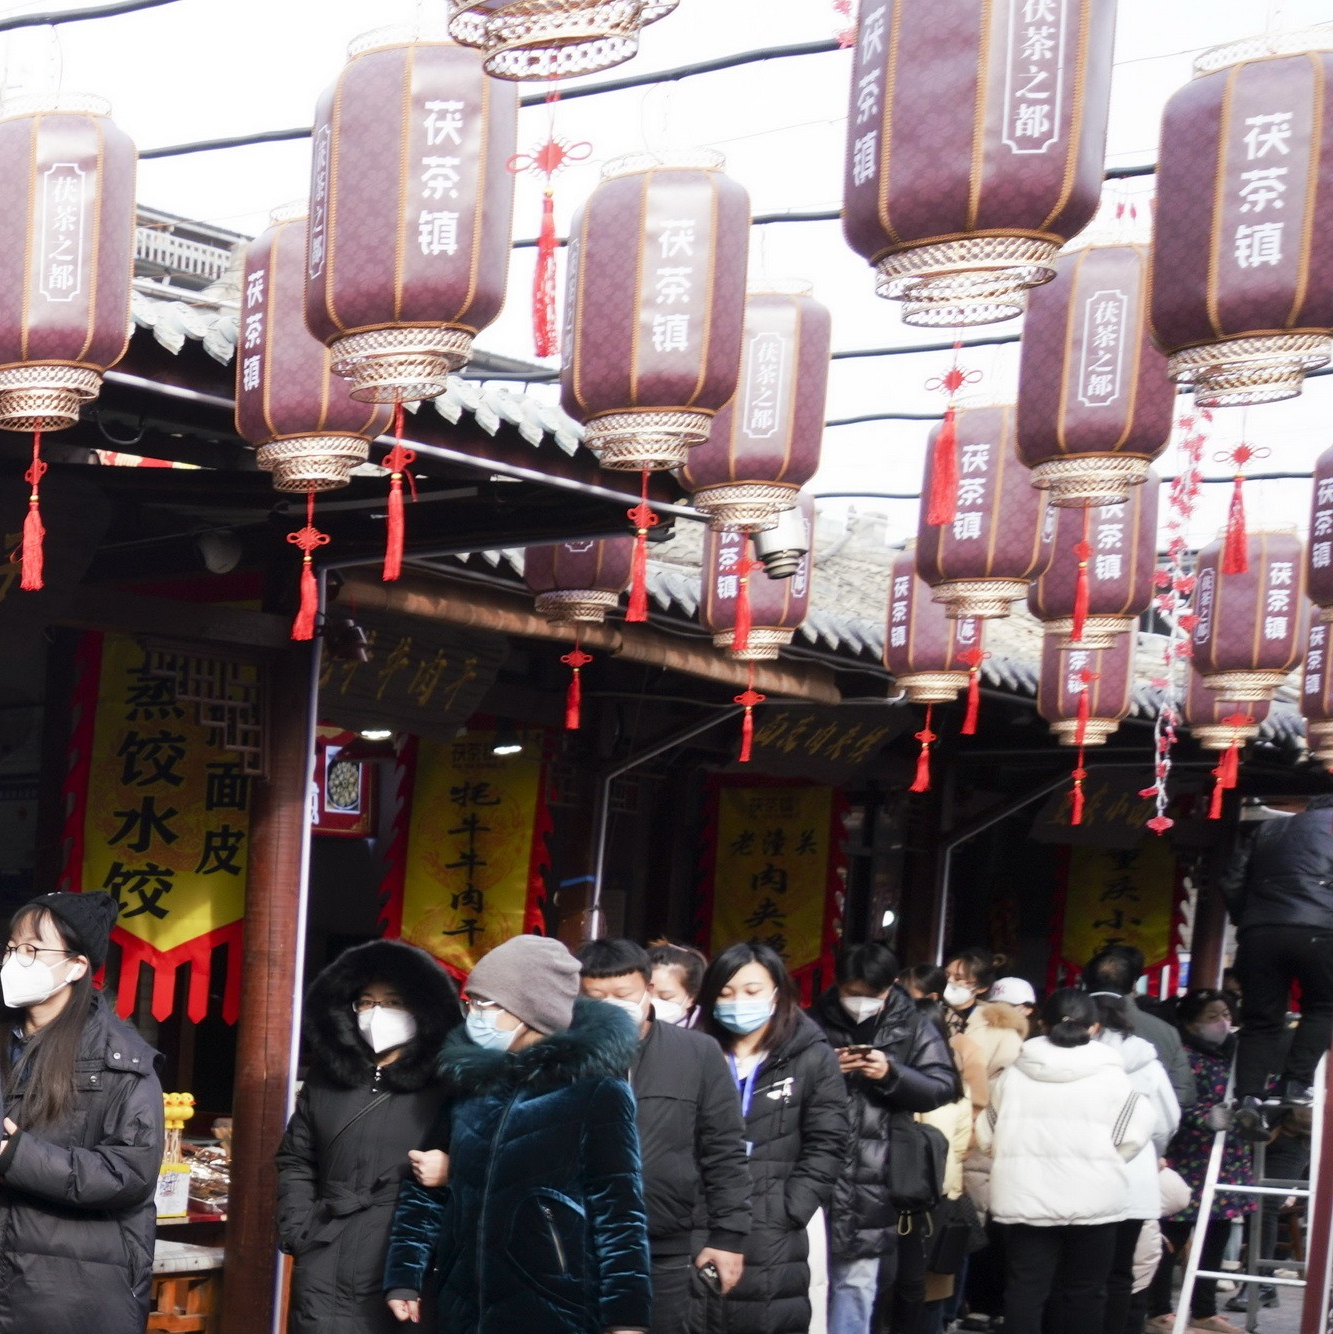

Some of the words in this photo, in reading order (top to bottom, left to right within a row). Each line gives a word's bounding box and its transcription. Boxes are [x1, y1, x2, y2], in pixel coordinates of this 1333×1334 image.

[852, 5, 884, 187] 茯茶镇
[418, 99, 465, 256] 茯茶镇
[1233, 111, 1294, 268] 茯茶镇
[48, 176, 78, 290] 茯茶之都
[651, 219, 696, 352] 茯茶镇
[243, 269, 265, 392] 茯茶镇
[1085, 300, 1120, 396] 茯茶之都
[750, 341, 779, 430] 茯茶之都
[953, 444, 990, 540] 茯茶镇
[890, 576, 909, 648] 茯茶镇
[1265, 562, 1294, 641] 茯茶镇
[1304, 625, 1326, 695] 茯茶镇
